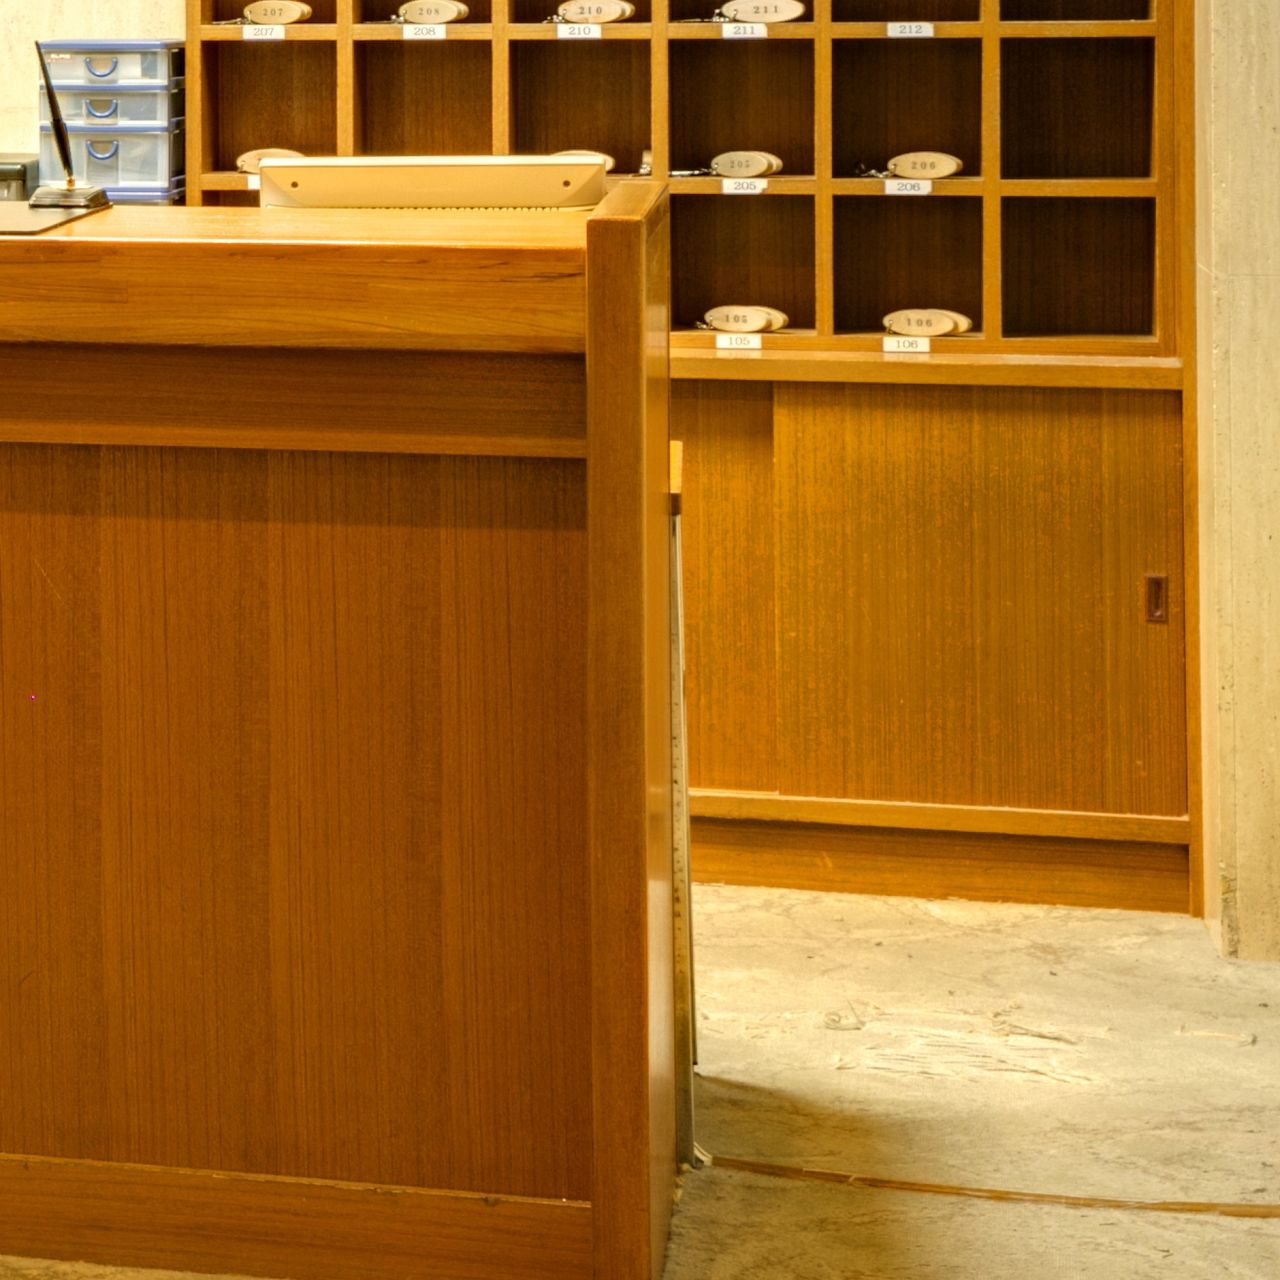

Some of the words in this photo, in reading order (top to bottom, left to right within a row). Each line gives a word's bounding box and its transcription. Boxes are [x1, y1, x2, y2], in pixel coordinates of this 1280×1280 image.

[262, 7, 285, 17] 207
[418, 7, 441, 16] 208
[578, 6, 604, 16] 210
[752, 5, 779, 15] 211
[253, 27, 275, 38] 207
[413, 26, 437, 37] 208
[568, 25, 592, 36] 210
[732, 25, 757, 36] 211
[898, 24, 923, 35] 212
[911, 161, 937, 171] 206
[733, 181, 757, 192] 205
[896, 182, 921, 193] 206
[906, 317, 933, 328] 106
[728, 336, 751, 346] 105
[895, 339, 919, 350] 106
